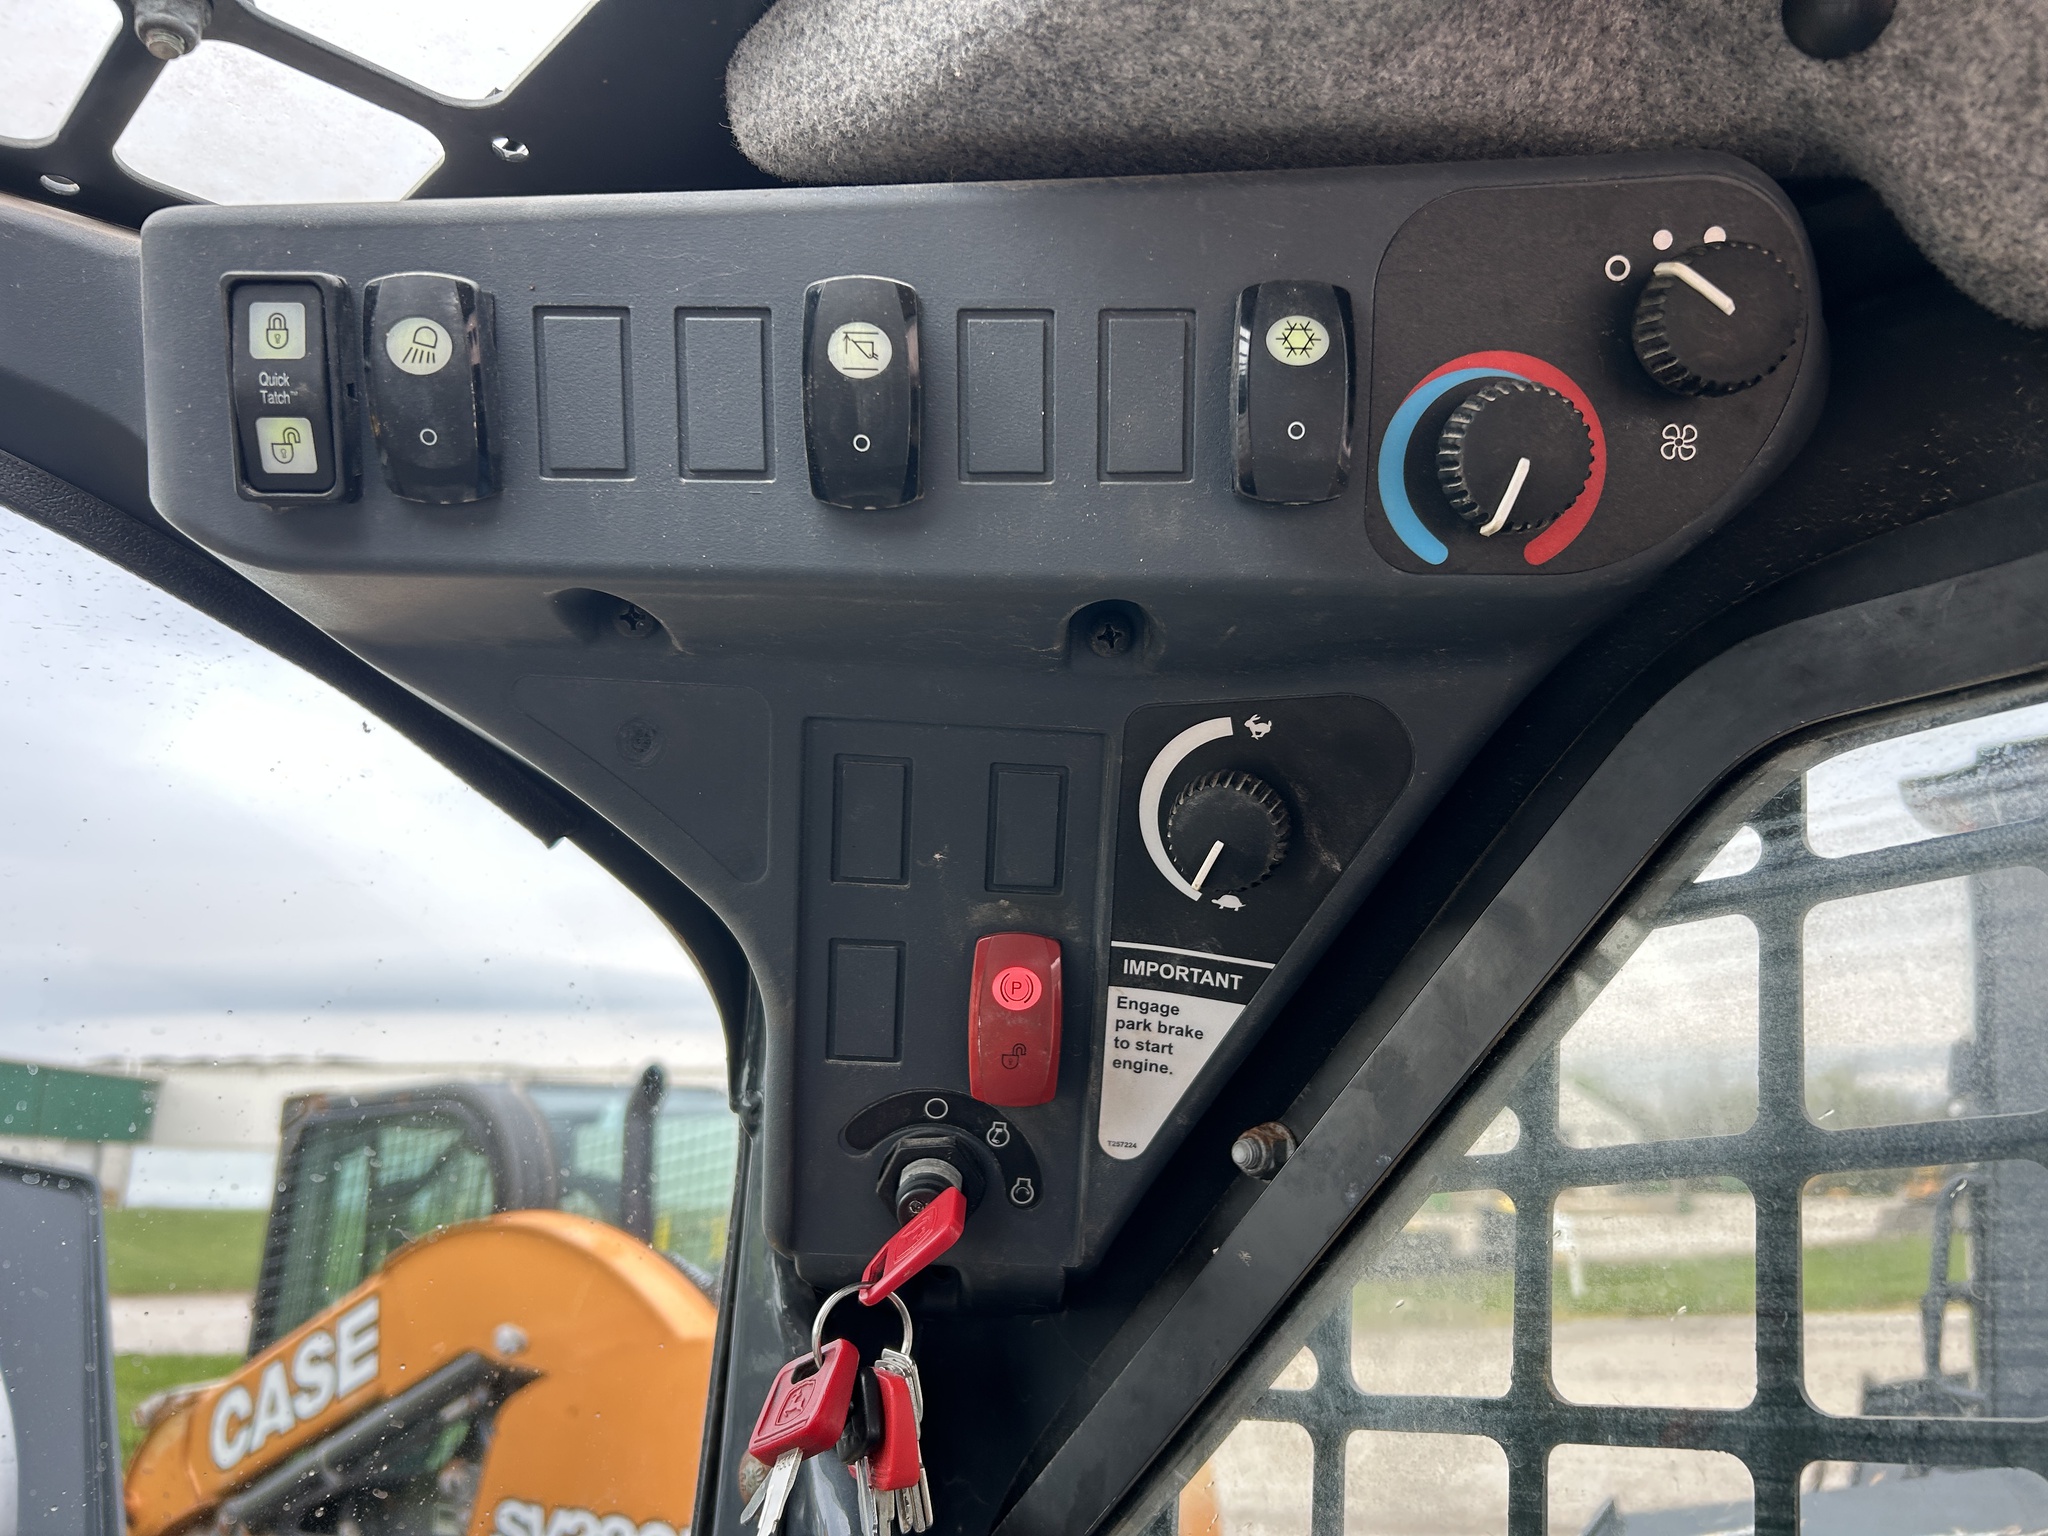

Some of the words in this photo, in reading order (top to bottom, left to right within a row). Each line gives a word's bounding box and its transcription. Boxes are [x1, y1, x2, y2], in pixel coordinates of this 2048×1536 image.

[259, 371, 290, 387] Quick
[1123, 959, 1243, 990] IMPORTANT
[1116, 996, 1180, 1017] Engage
[1115, 1018, 1152, 1032] park
[1157, 1020, 1204, 1040] brake
[1113, 1036, 1130, 1049] to
[1135, 1039, 1173, 1055] start
[1112, 1058, 1173, 1075] engine.
[1107, 1140, 1137, 1149] T257224
[211, 1296, 379, 1470] CASE
